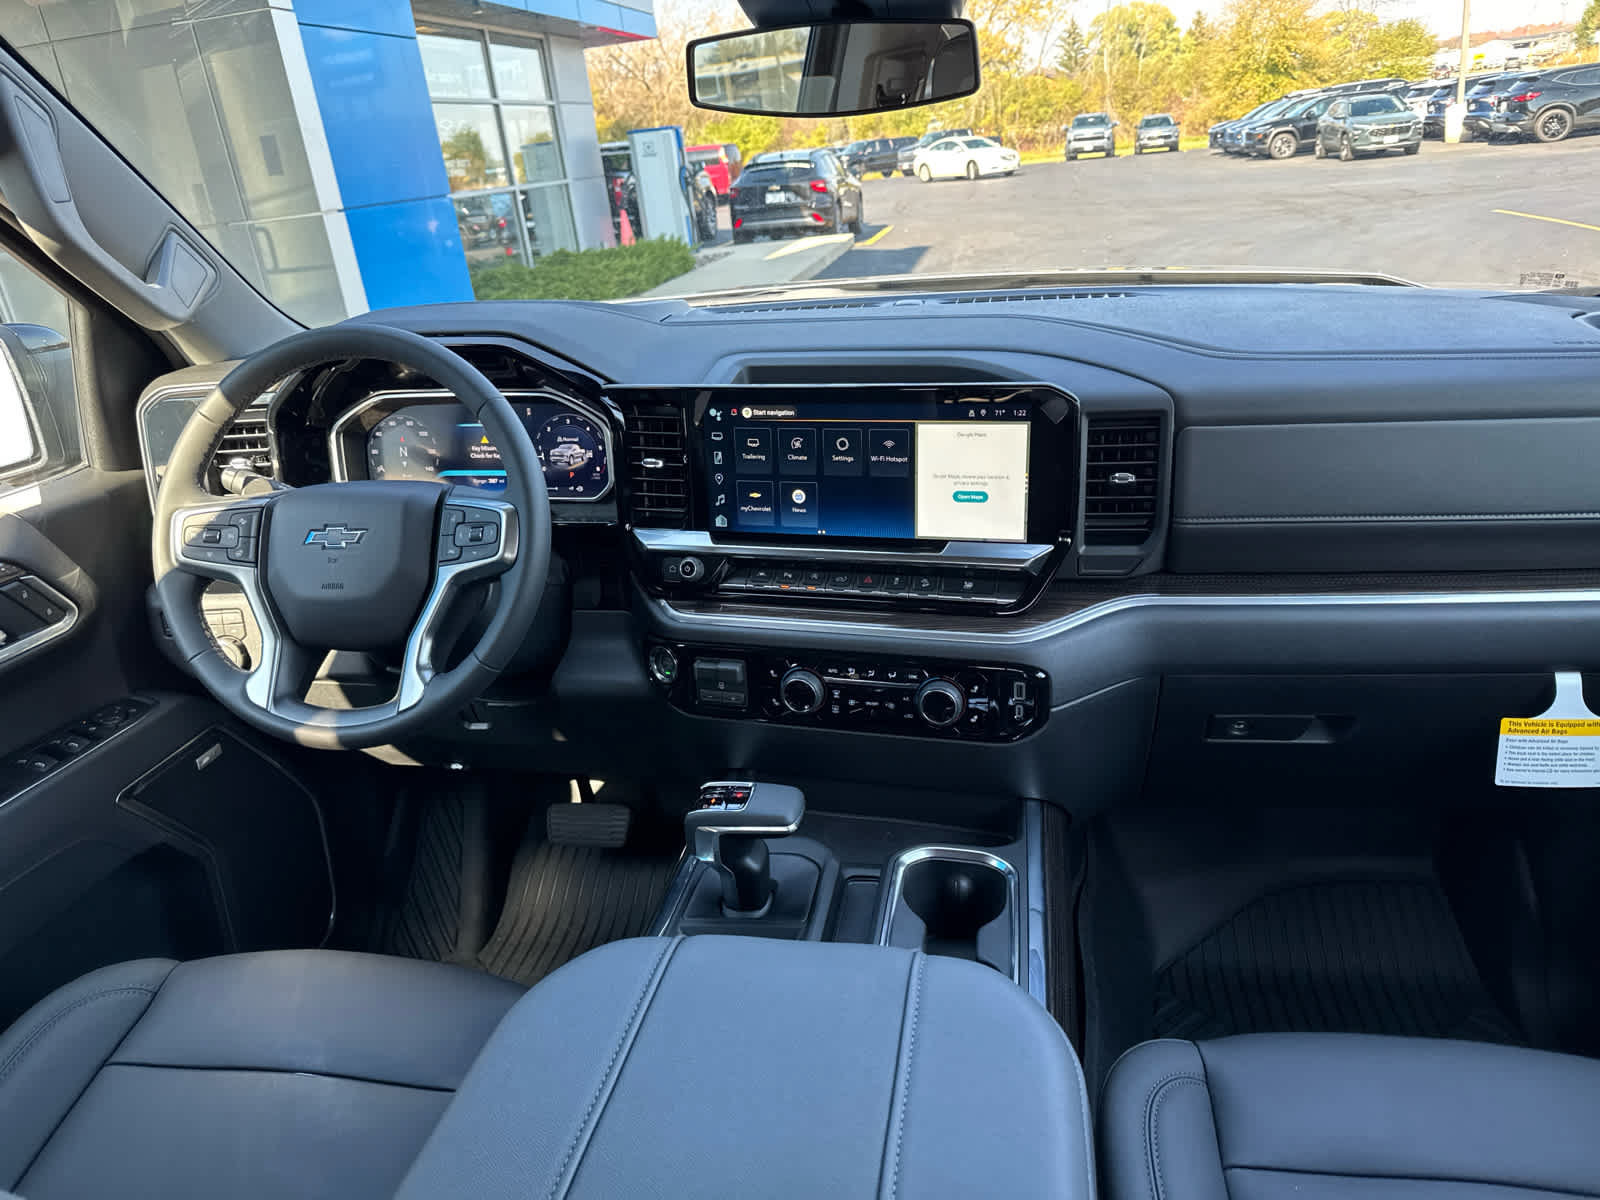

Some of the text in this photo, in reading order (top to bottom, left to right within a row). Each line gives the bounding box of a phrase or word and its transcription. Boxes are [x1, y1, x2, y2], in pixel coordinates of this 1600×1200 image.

[767, 409, 795, 417] navigation
[1013, 409, 1027, 417] 1:22
[399, 446, 408, 457] N
[742, 453, 766, 461] Trailering
[832, 454, 854, 462] Settings
[886, 455, 908, 463] Hotspot
[740, 505, 771, 513] myChevrolet
[1555, 721, 1585, 729] Equipped
[1551, 728, 1568, 736] Bags
